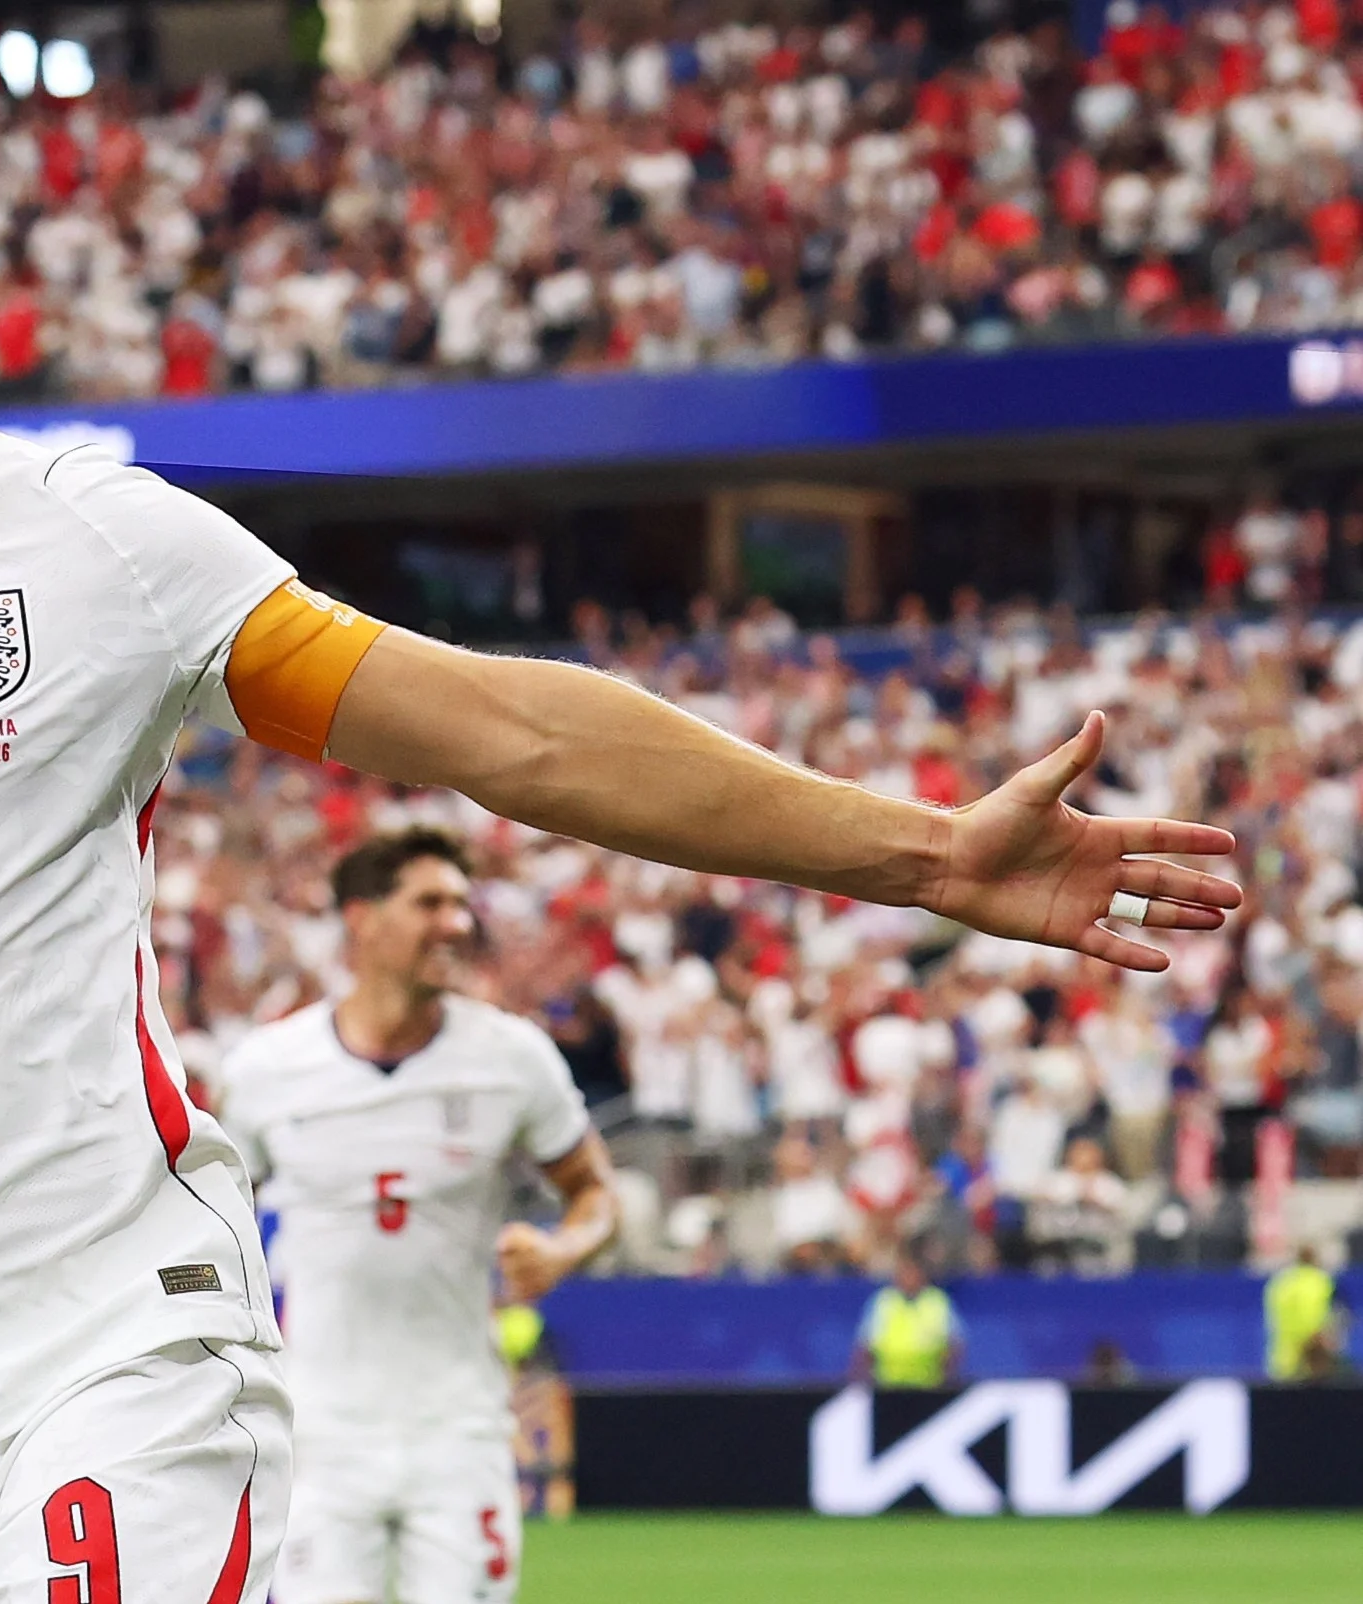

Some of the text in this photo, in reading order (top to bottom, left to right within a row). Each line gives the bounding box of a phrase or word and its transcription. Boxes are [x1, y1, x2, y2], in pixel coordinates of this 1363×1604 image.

[373, 1171, 408, 1235] 5
[808, 1377, 1251, 1517] KIA
[42, 1476, 122, 1604] 9
[478, 1507, 510, 1582] 5
